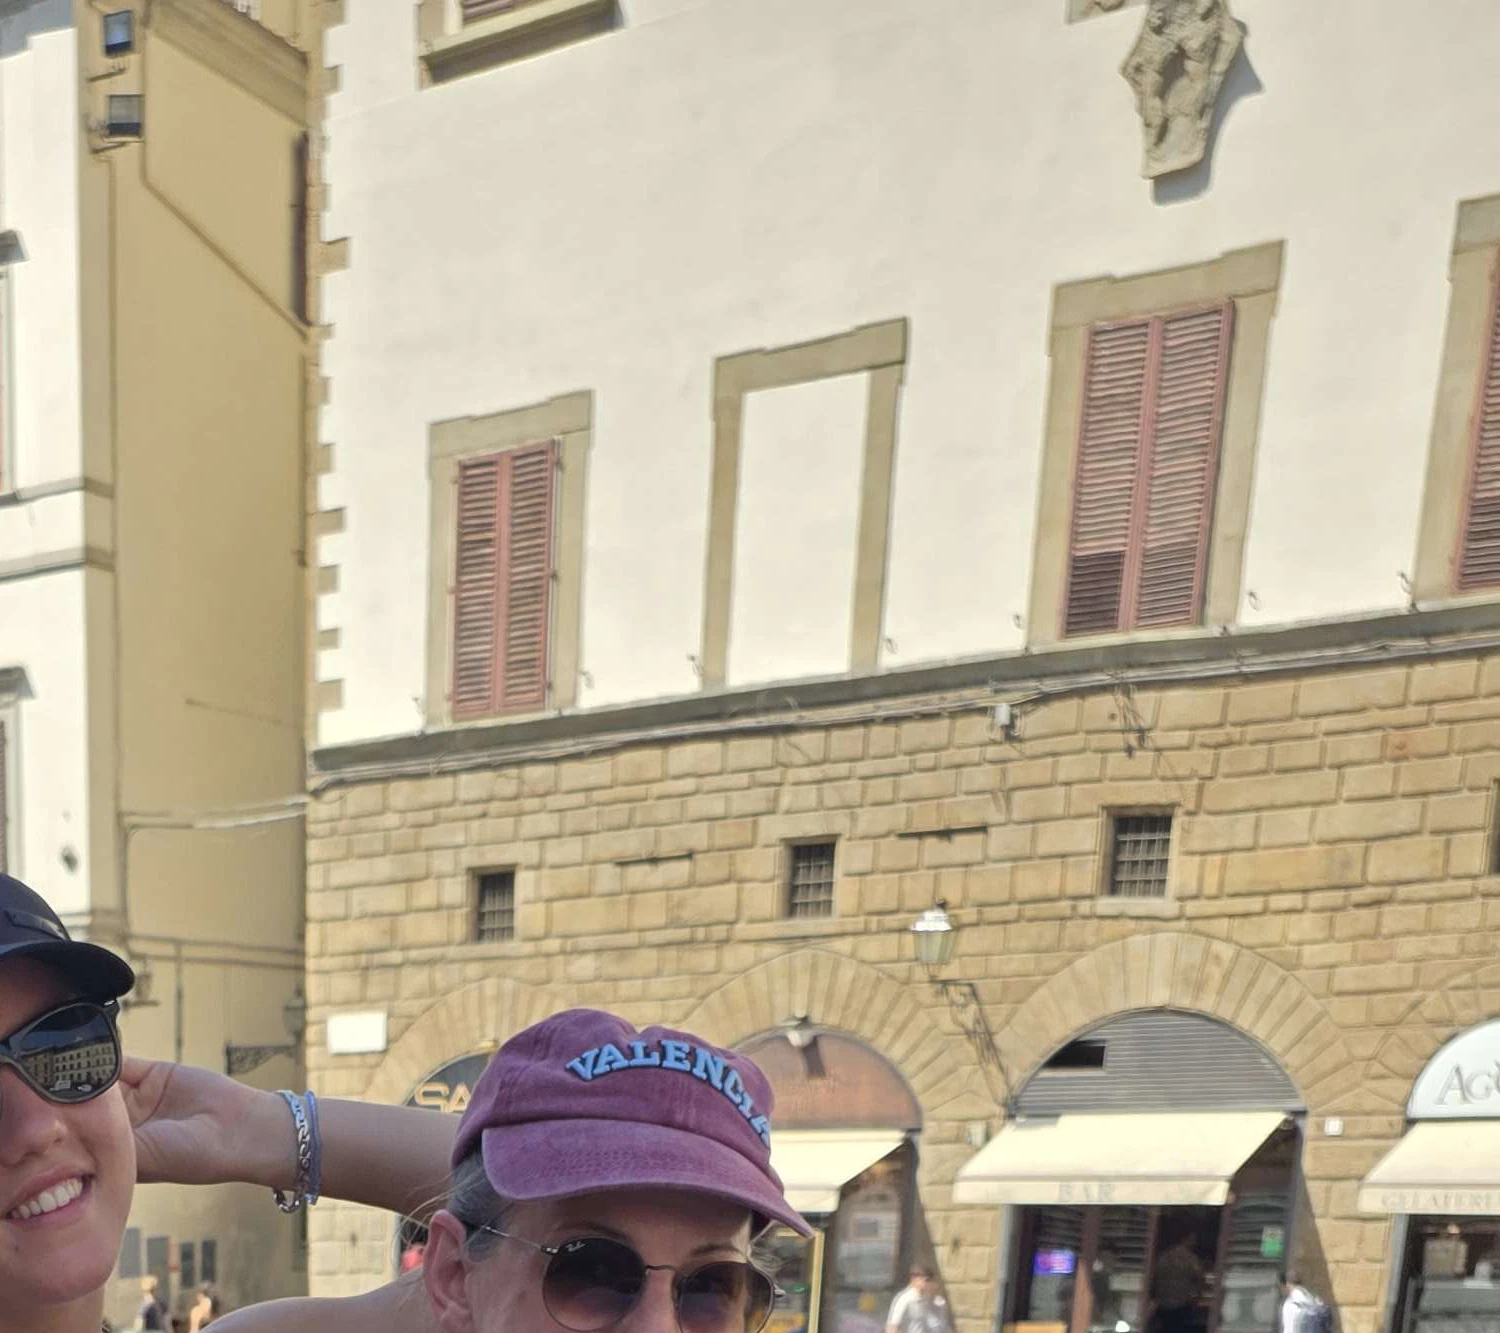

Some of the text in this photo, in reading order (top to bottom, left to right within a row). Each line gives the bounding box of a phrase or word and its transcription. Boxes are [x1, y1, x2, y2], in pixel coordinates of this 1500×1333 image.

[414, 1082, 472, 1114] SA
[565, 1038, 771, 1147] VALENCIA
[1380, 1190, 1500, 1212] GELATERI
